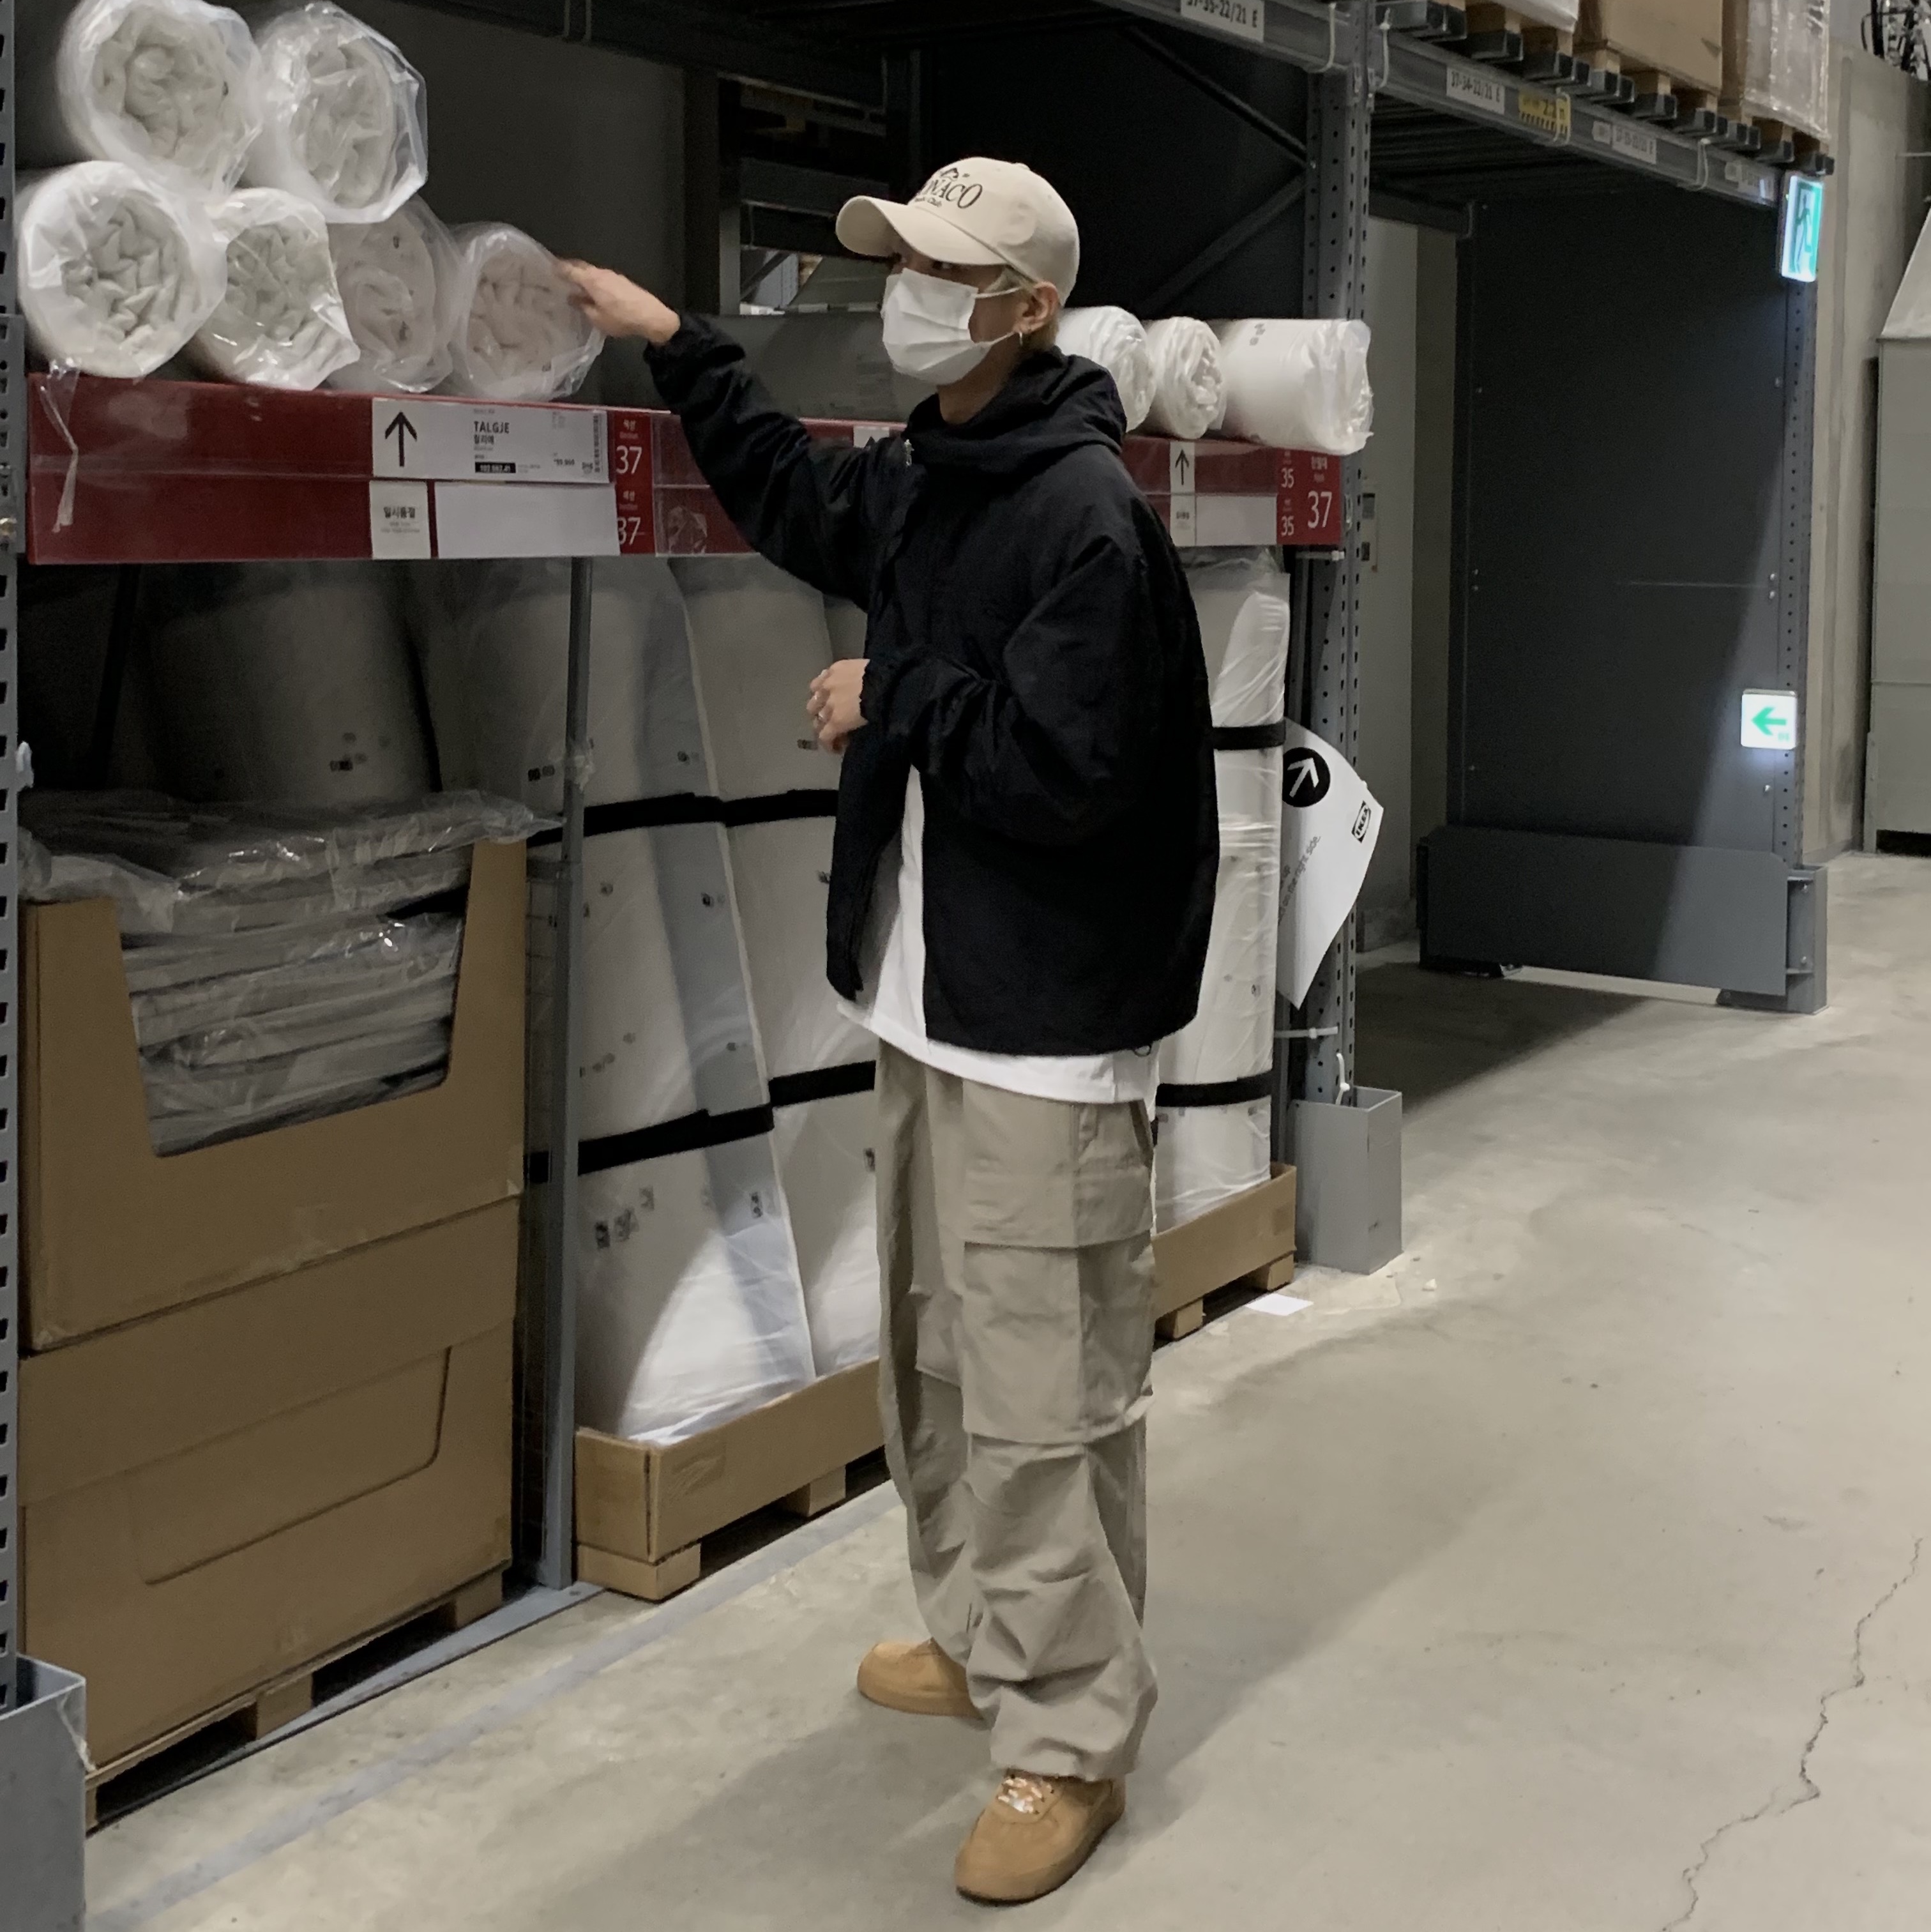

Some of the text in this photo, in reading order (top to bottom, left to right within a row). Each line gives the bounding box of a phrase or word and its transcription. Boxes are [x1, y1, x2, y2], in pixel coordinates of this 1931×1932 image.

[922, 179, 983, 209] NACO
[474, 420, 510, 434] TALGJE
[616, 445, 642, 475] 37
[1281, 467, 1295, 489] 35
[1307, 490, 1333, 529] 37
[616, 516, 642, 545] 37
[1281, 515, 1295, 537] 35
[1355, 807, 1370, 837] IKEA
